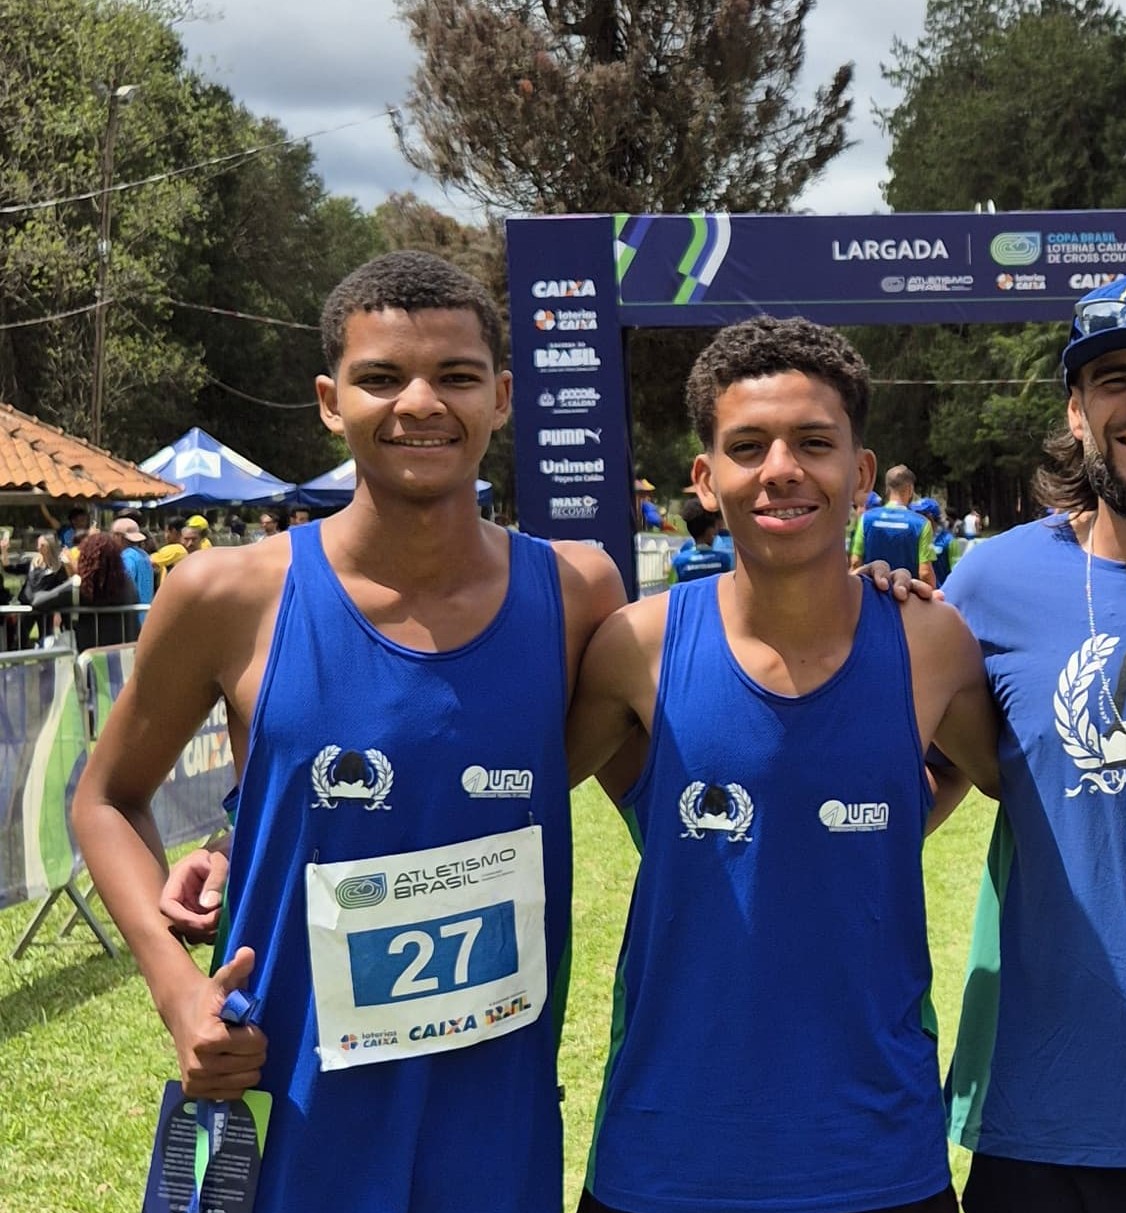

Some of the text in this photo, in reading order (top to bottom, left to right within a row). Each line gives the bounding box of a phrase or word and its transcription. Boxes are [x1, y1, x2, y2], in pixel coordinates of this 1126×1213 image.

[1048, 232, 1117, 243] COPA BRASIL
[832, 239, 949, 261] LARGADA
[1048, 244, 1095, 253] LOTERIAS
[1048, 253, 1061, 263] DE
[1063, 253, 1100, 263] CROSS
[531, 280, 597, 298] CAIXA
[907, 275, 974, 285] ATLETISMO
[556, 319, 598, 331] CAIXA
[533, 348, 601, 368] BRASIL
[539, 428, 586, 446] PUMA
[540, 457, 605, 475] Unimed
[551, 497, 583, 507] MAX
[394, 848, 516, 886] ATLETISMO
[393, 873, 479, 900] BRASIL
[388, 916, 483, 998] 27
[361, 1029, 398, 1040] loterias
[408, 1014, 478, 1042] CAIXA
[362, 1036, 399, 1049] CAIXA
